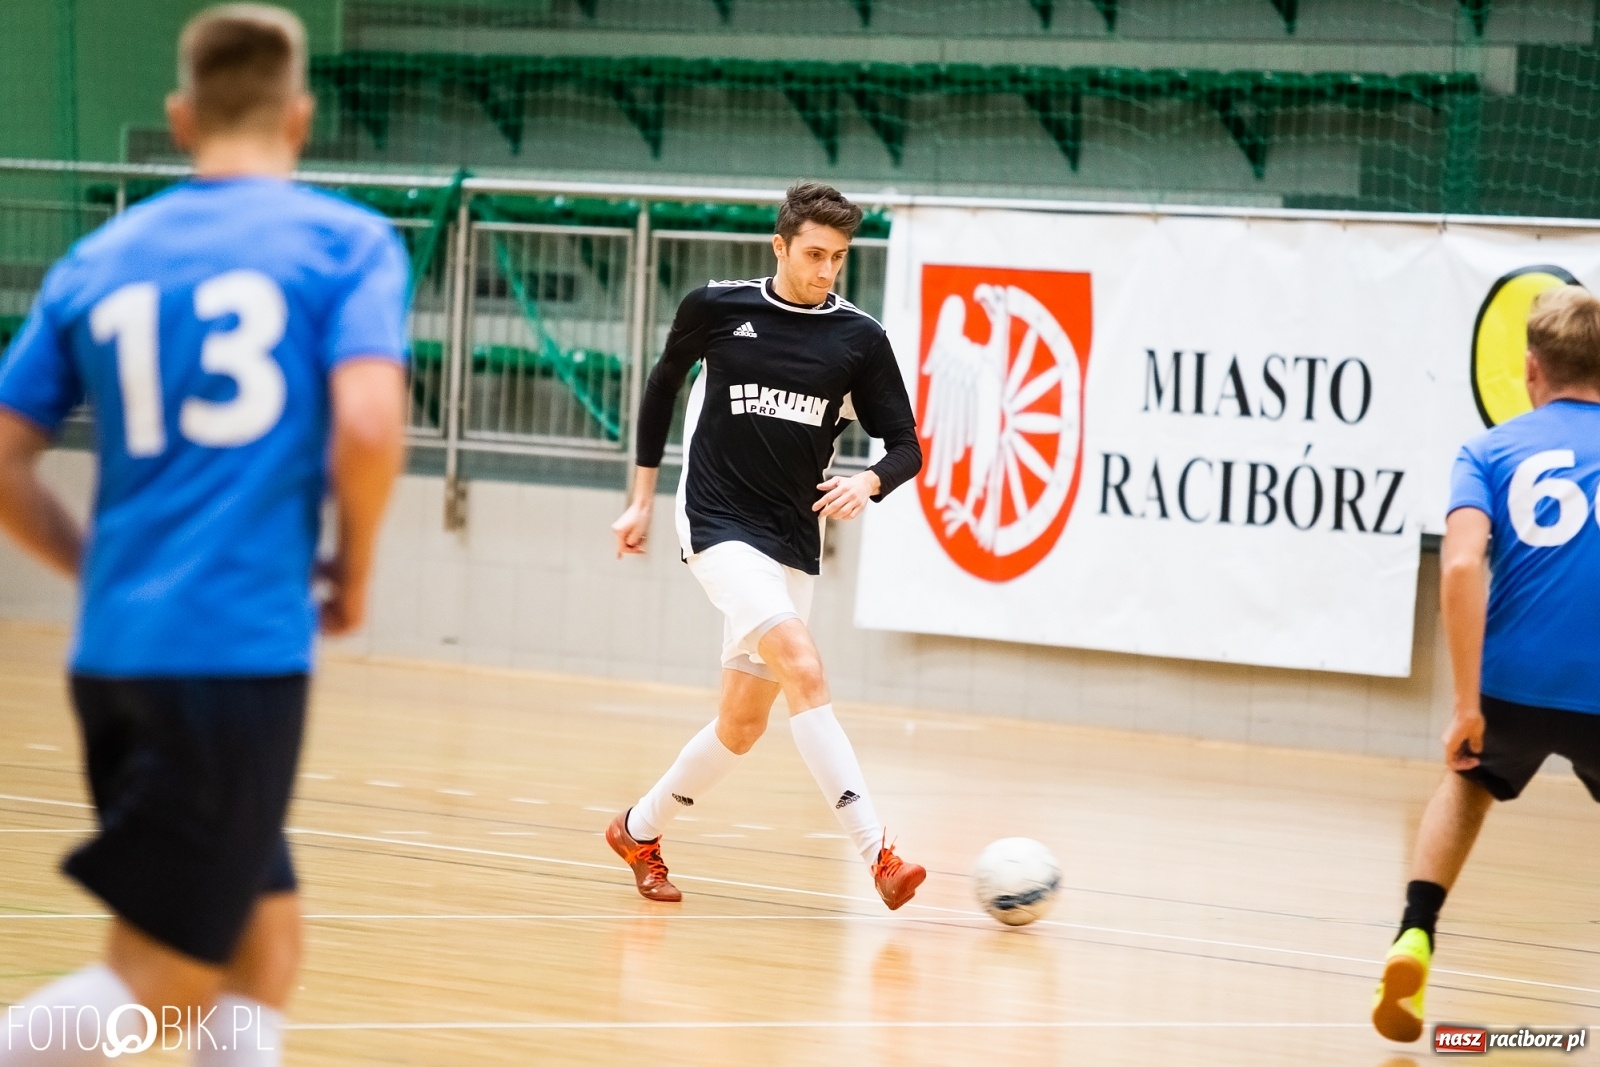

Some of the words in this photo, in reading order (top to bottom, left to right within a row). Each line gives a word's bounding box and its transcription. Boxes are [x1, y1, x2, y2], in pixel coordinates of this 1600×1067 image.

[89, 269, 288, 458] 13
[733, 330, 758, 338] adidas
[750, 404, 777, 415] PRD
[758, 386, 829, 427] KUHN
[1141, 349, 1372, 425] MIASTO
[1097, 443, 1406, 535] RACIBÓRZ
[1507, 449, 1600, 547] 6
